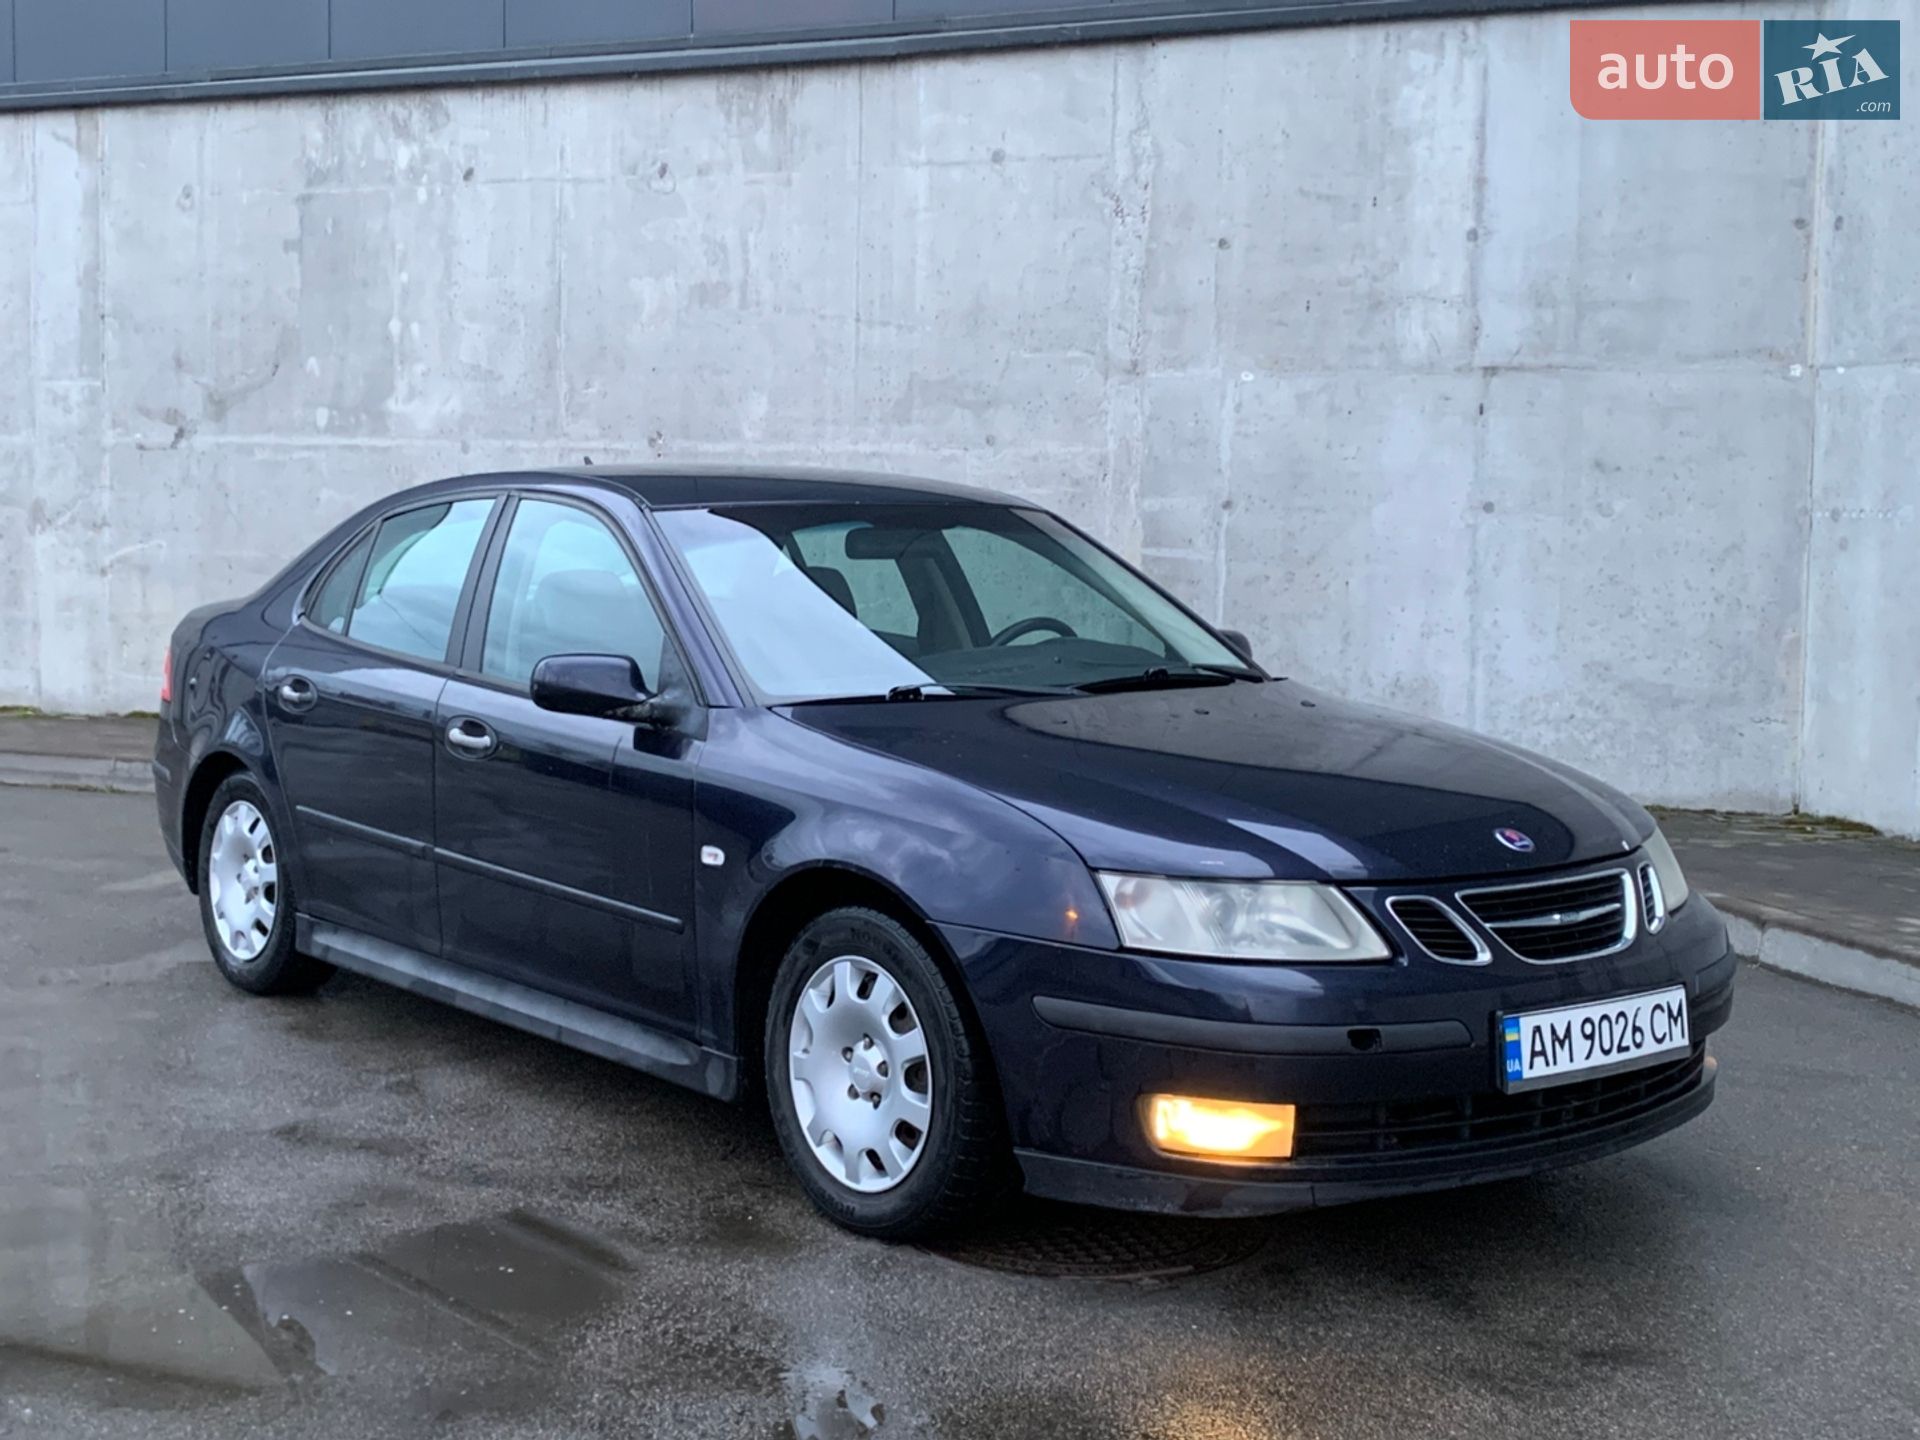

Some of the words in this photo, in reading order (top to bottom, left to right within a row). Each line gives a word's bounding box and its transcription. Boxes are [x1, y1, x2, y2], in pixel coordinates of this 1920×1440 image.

[1528, 1019, 1574, 1071] AM
[1580, 1006, 1645, 1061] 9026
[1650, 998, 1686, 1045] CM
[1506, 1058, 1522, 1073] UA
